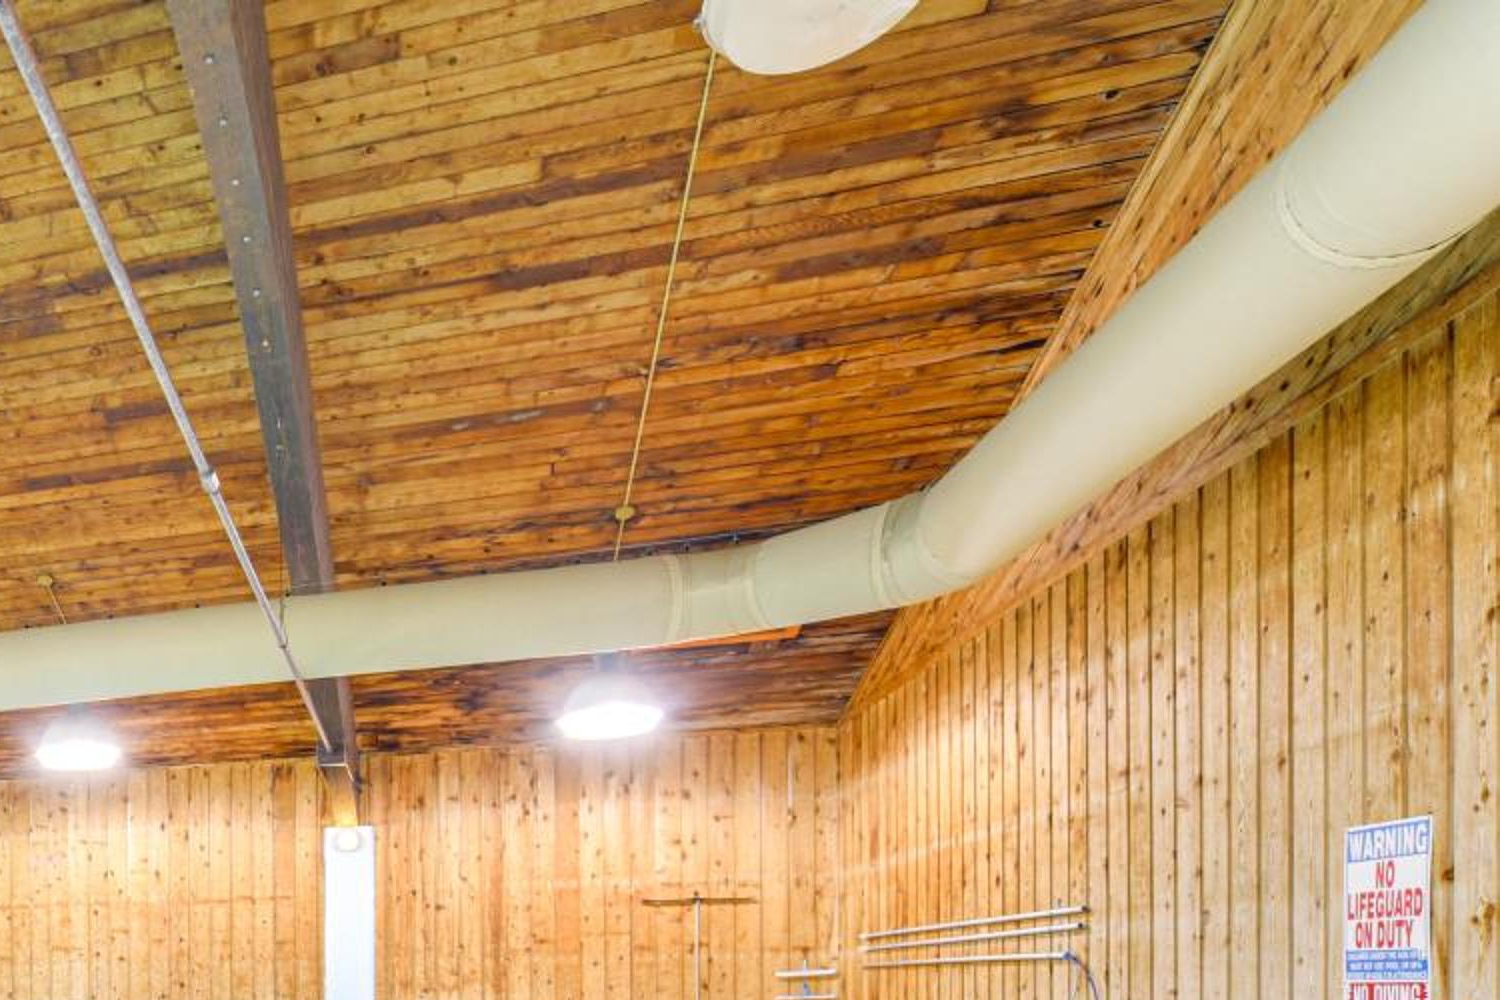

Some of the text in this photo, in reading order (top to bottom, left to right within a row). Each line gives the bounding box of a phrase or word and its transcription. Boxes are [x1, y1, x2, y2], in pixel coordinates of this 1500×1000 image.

[1347, 822, 1429, 862] WARNING
[1375, 860, 1396, 889] NO
[1347, 887, 1423, 920] LIFEGUARD
[1355, 918, 1413, 949] ON DUTY
